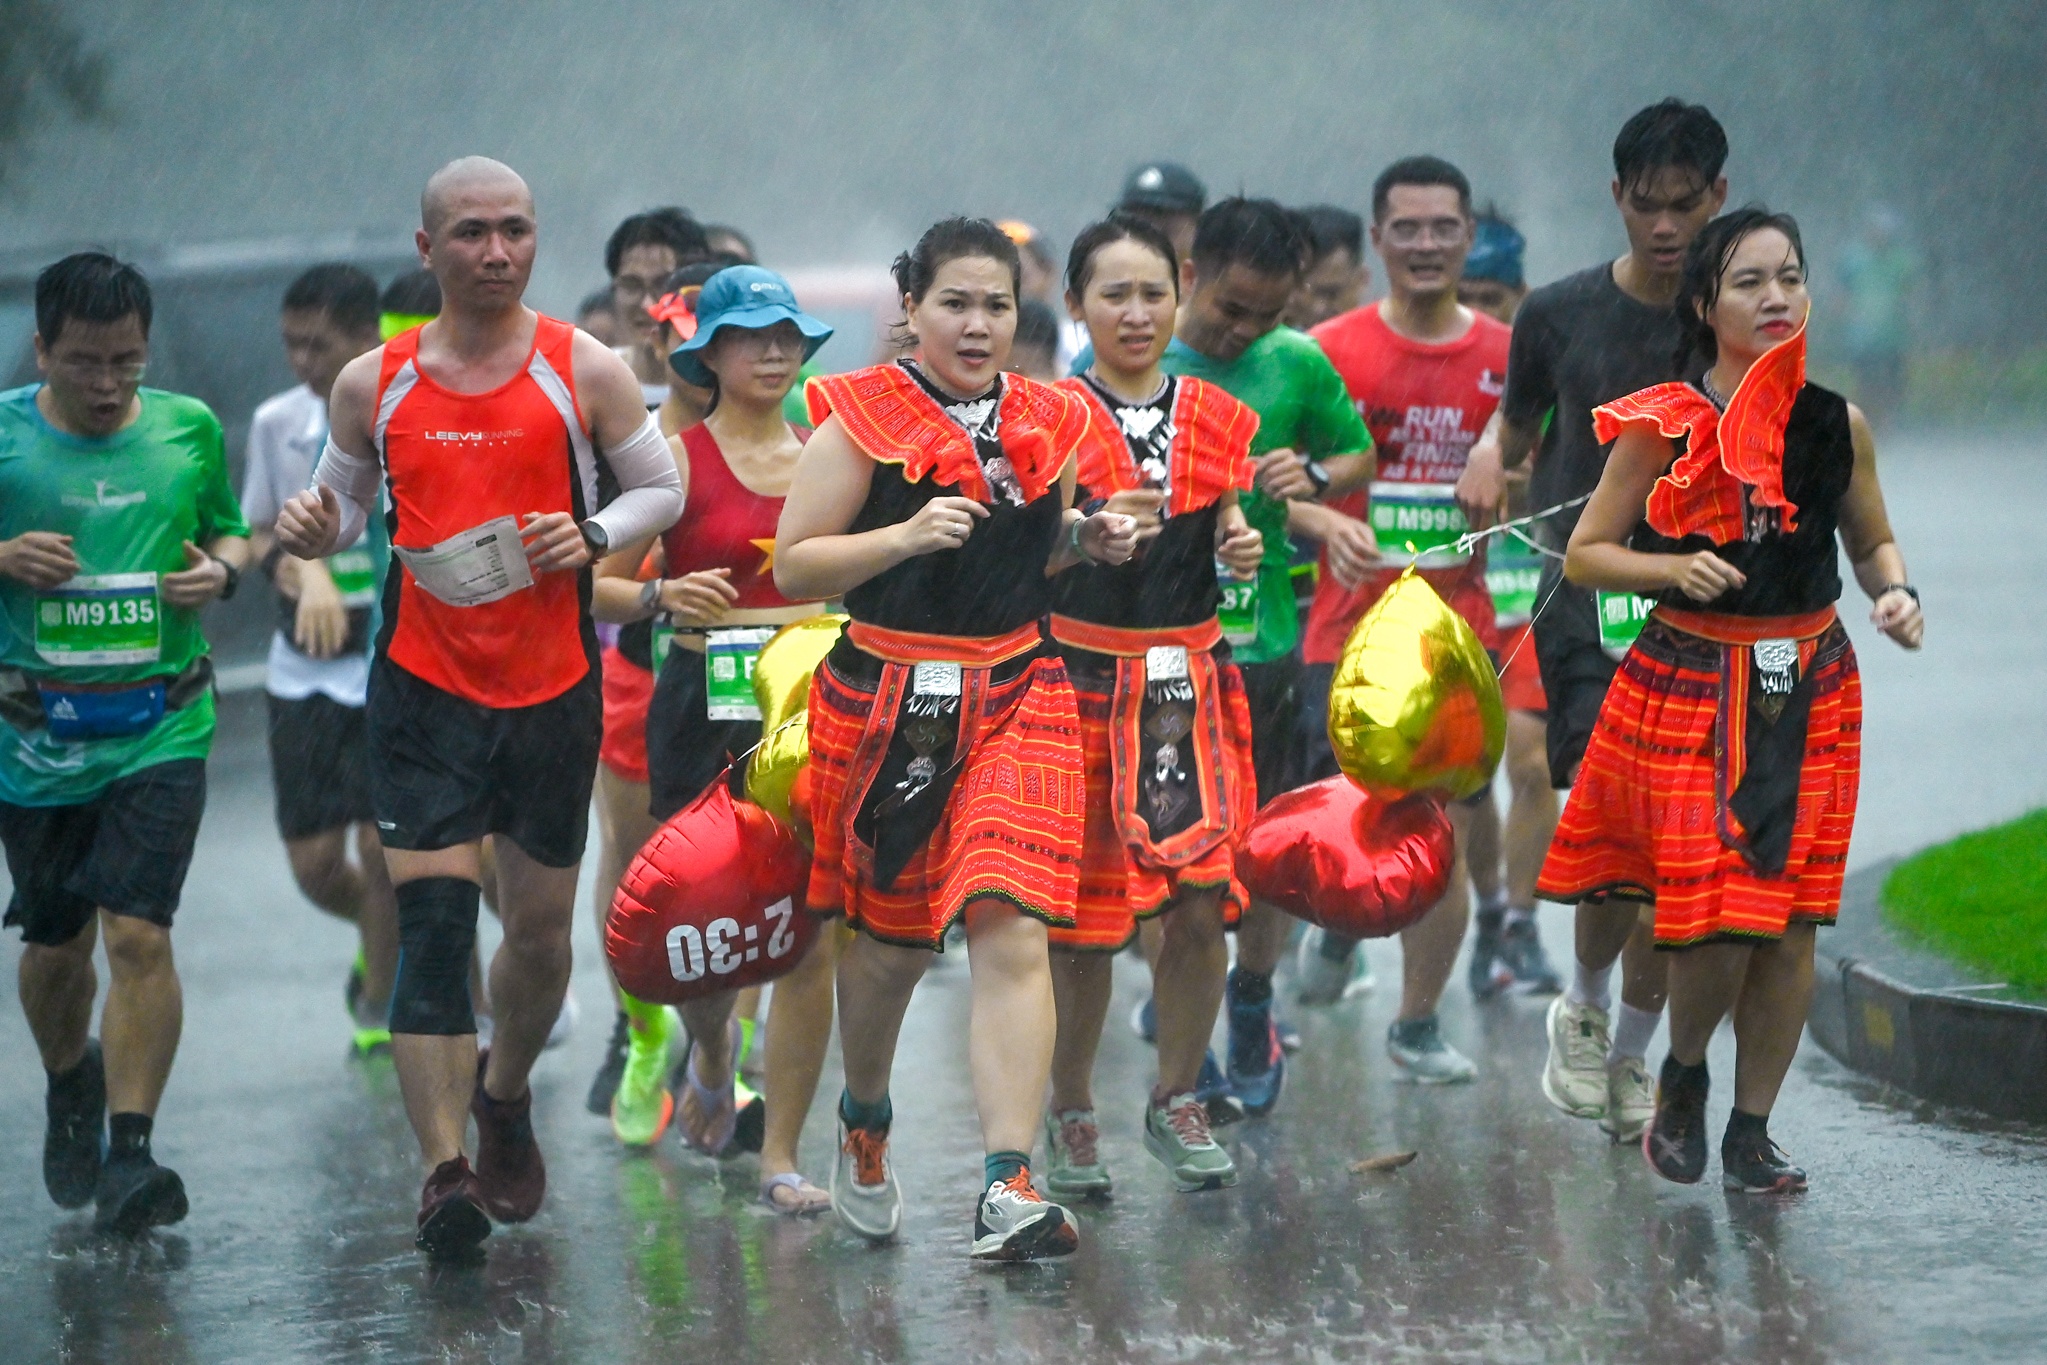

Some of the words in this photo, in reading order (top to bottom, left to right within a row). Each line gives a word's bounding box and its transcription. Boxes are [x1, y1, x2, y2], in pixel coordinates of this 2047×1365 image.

[1404, 405, 1464, 429] RUN
[1218, 587, 1253, 610] 87
[1631, 595, 1658, 620] M
[66, 599, 155, 626] M9135
[665, 895, 795, 982] 2:30
